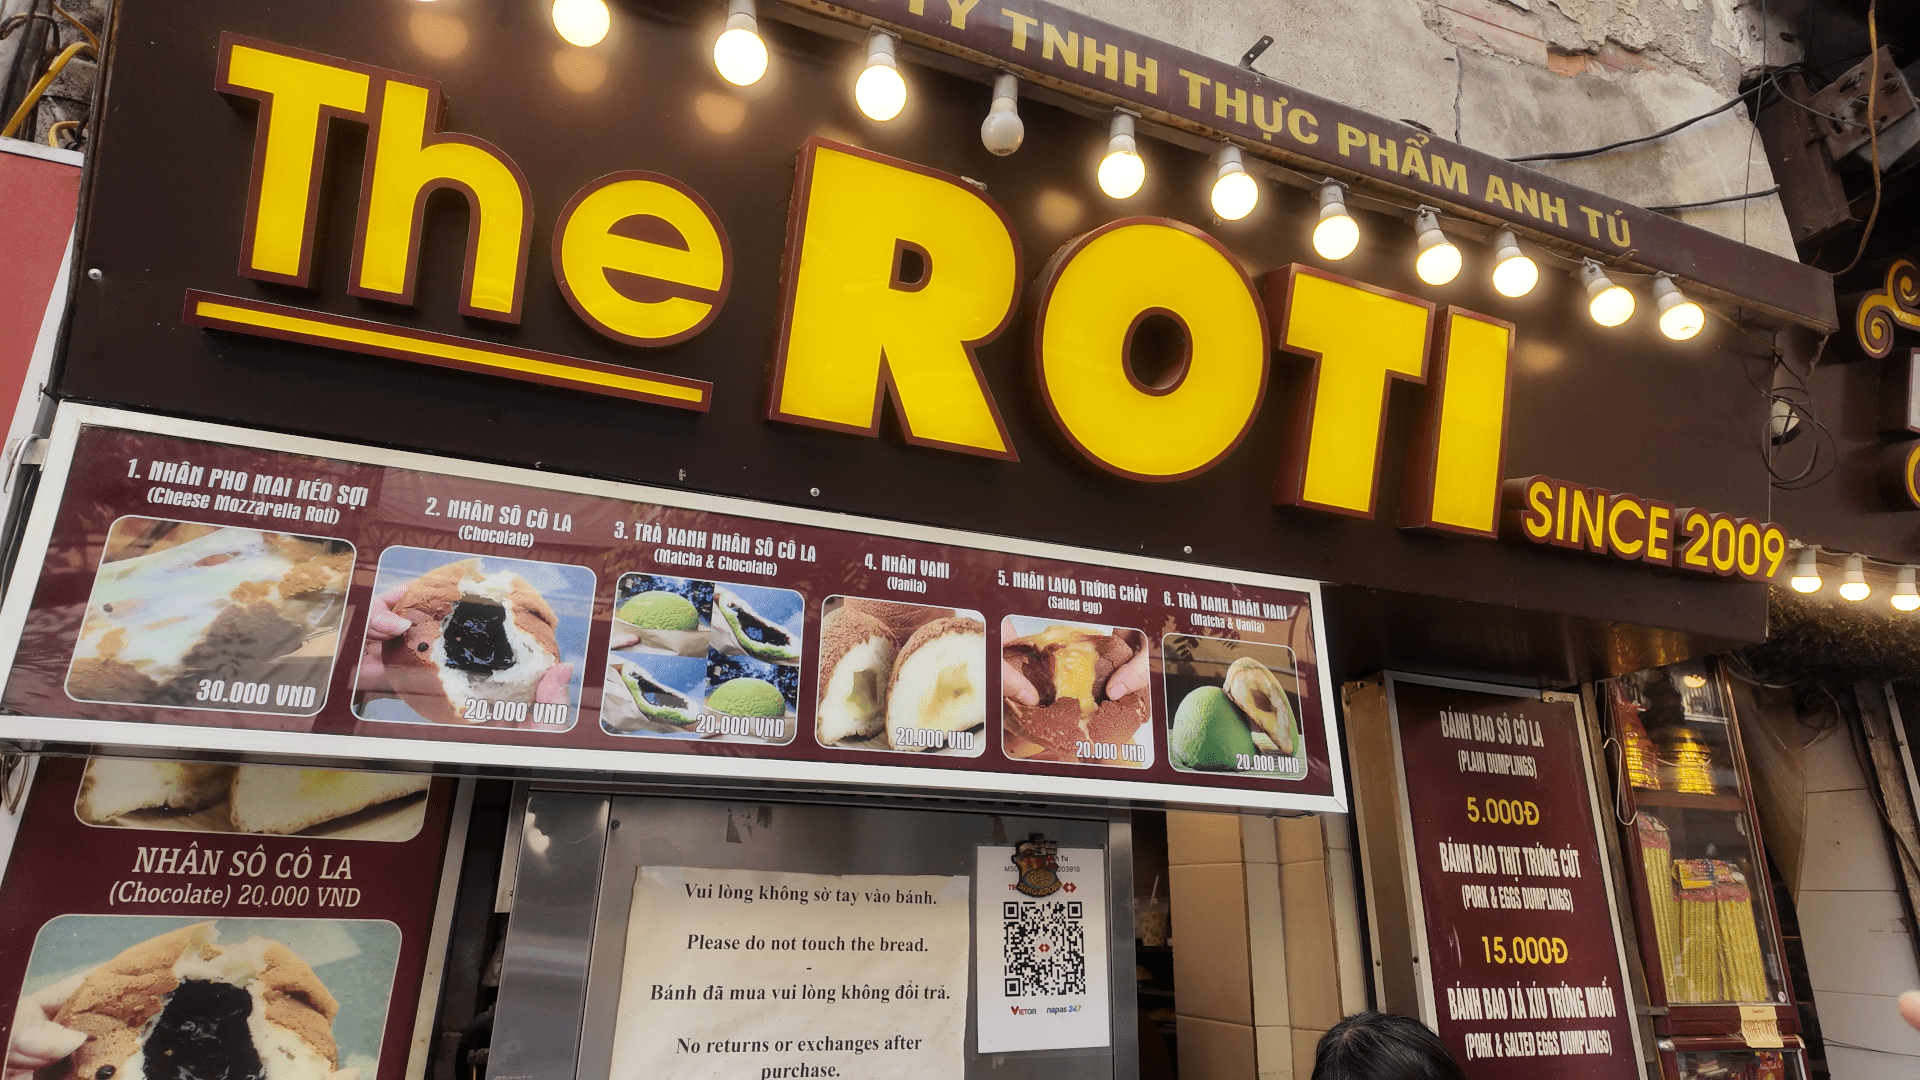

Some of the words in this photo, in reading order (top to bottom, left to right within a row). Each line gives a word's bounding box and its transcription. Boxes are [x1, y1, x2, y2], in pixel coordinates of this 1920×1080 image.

[1001, 7, 1158, 95] TNHH
[1178, 67, 1319, 145] THỰC
[1337, 132, 1469, 195] PHẨM
[1484, 174, 1569, 228] ANH
[1579, 205, 1632, 248] TÚ
[223, 39, 728, 342] The
[775, 142, 1515, 537] ROTI
[127, 459, 141, 479] 1.
[148, 460, 204, 486] NHÂN
[208, 468, 248, 492] PHO
[252, 473, 292, 497] MAI
[297, 478, 333, 502] KÉO
[337, 484, 369, 510] SỢI
[146, 486, 211, 508] (Cheese
[214, 494, 301, 519] Mozzarella
[305, 506, 340, 525] Roti)
[425, 497, 441, 516] 2.
[447, 499, 494, 522] NHÂN
[499, 504, 522, 526] SÔ
[526, 508, 548, 529] CÔ
[552, 513, 572, 532] LA
[458, 525, 534, 548] (Chocolate)
[614, 521, 628, 540] 3.
[634, 522, 662, 543] TRÀ
[667, 527, 707, 549] XANH
[712, 533, 751, 554] NHÂN
[755, 537, 774, 557] SÔ
[778, 540, 796, 560] CÔ
[800, 545, 816, 562] LA
[1526, 481, 1670, 560] SINCE
[1685, 513, 1785, 578] 2009
[654, 549, 703, 567] (Matcha
[705, 554, 714, 569] &
[718, 555, 778, 576] Chocolate)
[864, 553, 878, 570] 4.
[881, 555, 916, 576] NHÂN
[920, 559, 950, 579] VANI
[887, 576, 927, 594] (Vanila)
[998, 570, 1010, 587] 5.
[1012, 571, 1045, 591] NHÂN
[1048, 576, 1077, 595] LAVA
[1080, 579, 1116, 600] TRỨNG
[1119, 584, 1148, 604] CHẢY
[1048, 596, 1081, 612] (Salted
[1083, 603, 1102, 615] egg)
[1163, 591, 1175, 606] 6.
[1177, 591, 1198, 609] TRÀ
[1200, 595, 1229, 613] XANH
[1232, 599, 1260, 617] NHÂN
[1262, 603, 1288, 620] VANI
[1190, 613, 1225, 629] (Matcha
[1227, 618, 1233, 630] &
[1236, 618, 1265, 633] Vanila)
[196, 679, 270, 705] 30.000
[275, 686, 317, 708] VND
[463, 698, 528, 722] 20.000
[532, 703, 568, 725] VND
[695, 714, 751, 736] 20.000
[755, 717, 785, 738] VND
[896, 727, 945, 748] 20.000
[947, 731, 974, 750] VND
[1440, 706, 1472, 740] BÁNH
[1472, 714, 1495, 743] BAO
[1496, 712, 1512, 744] SÔ
[1513, 714, 1529, 746] CÔ
[1529, 720, 1544, 747] LA
[1075, 741, 1118, 760] 20.000
[1121, 744, 1145, 762] VND
[1236, 753, 1275, 772] 20.000
[1278, 756, 1300, 773] VND
[1458, 750, 1486, 773] (PLAIN
[1486, 752, 1537, 779] DUMPLINGS)
[1467, 797, 1539, 825] 5.000Đ
[132, 841, 223, 875] NHÂN
[229, 844, 267, 877] SÔ
[275, 846, 312, 878] CÔ
[319, 854, 352, 880] LA
[1439, 837, 1473, 873] BÁNH
[1473, 844, 1498, 874] BAO
[1497, 846, 1522, 882] THỊT
[1522, 842, 1560, 877] TRỨNG
[1560, 843, 1581, 878] CÚT
[109, 880, 231, 907] (Chocolate)
[238, 884, 310, 906] 20.000
[317, 887, 361, 907] VND
[684, 883, 713, 899] Vui
[718, 885, 754, 903] lòng
[759, 885, 809, 905] không
[813, 889, 831, 901] sờ
[836, 890, 860, 906] tay
[864, 889, 891, 903] vào
[896, 890, 938, 905] bánh.
[1462, 885, 1490, 910] (PORK
[1490, 886, 1498, 908] &
[1498, 886, 1522, 909] EGGS
[1521, 887, 1574, 913] DUMPLINGS)
[686, 934, 740, 950] Please
[745, 935, 765, 950] do
[771, 937, 797, 951] not
[802, 936, 845, 951] touch
[851, 936, 874, 951] the
[880, 937, 929, 952] bread.
[1482, 936, 1568, 964] 15.000Đ
[650, 984, 697, 1001] Bánh
[702, 984, 724, 1001] đã
[729, 988, 766, 1000] mua
[772, 985, 797, 1000] vui
[802, 984, 836, 1003] lòng
[841, 984, 890, 1003] không
[895, 980, 919, 1000] đổi
[924, 984, 951, 1000] trả.
[1447, 981, 1483, 1020] BÁNH
[1482, 988, 1508, 1019] BAO
[1508, 981, 1527, 1019] XÁ
[1525, 981, 1548, 1019] XÍU
[1547, 981, 1586, 1019] TRỨNG
[1585, 976, 1616, 1018] MUỐI
[1047, 1007, 1067, 1015] napas
[676, 1038, 701, 1054] No
[706, 1038, 769, 1053] returns
[774, 1039, 793, 1052] or
[798, 1036, 880, 1055] exchanges
[884, 1035, 923, 1051] after
[1465, 1033, 1494, 1061] (PORK
[1495, 1033, 1503, 1057] &
[1504, 1031, 1536, 1058] SALTED
[1535, 1031, 1560, 1056] EGGS
[1559, 1030, 1612, 1056] DUMPLINGS)
[761, 1063, 840, 1080] purchase.
